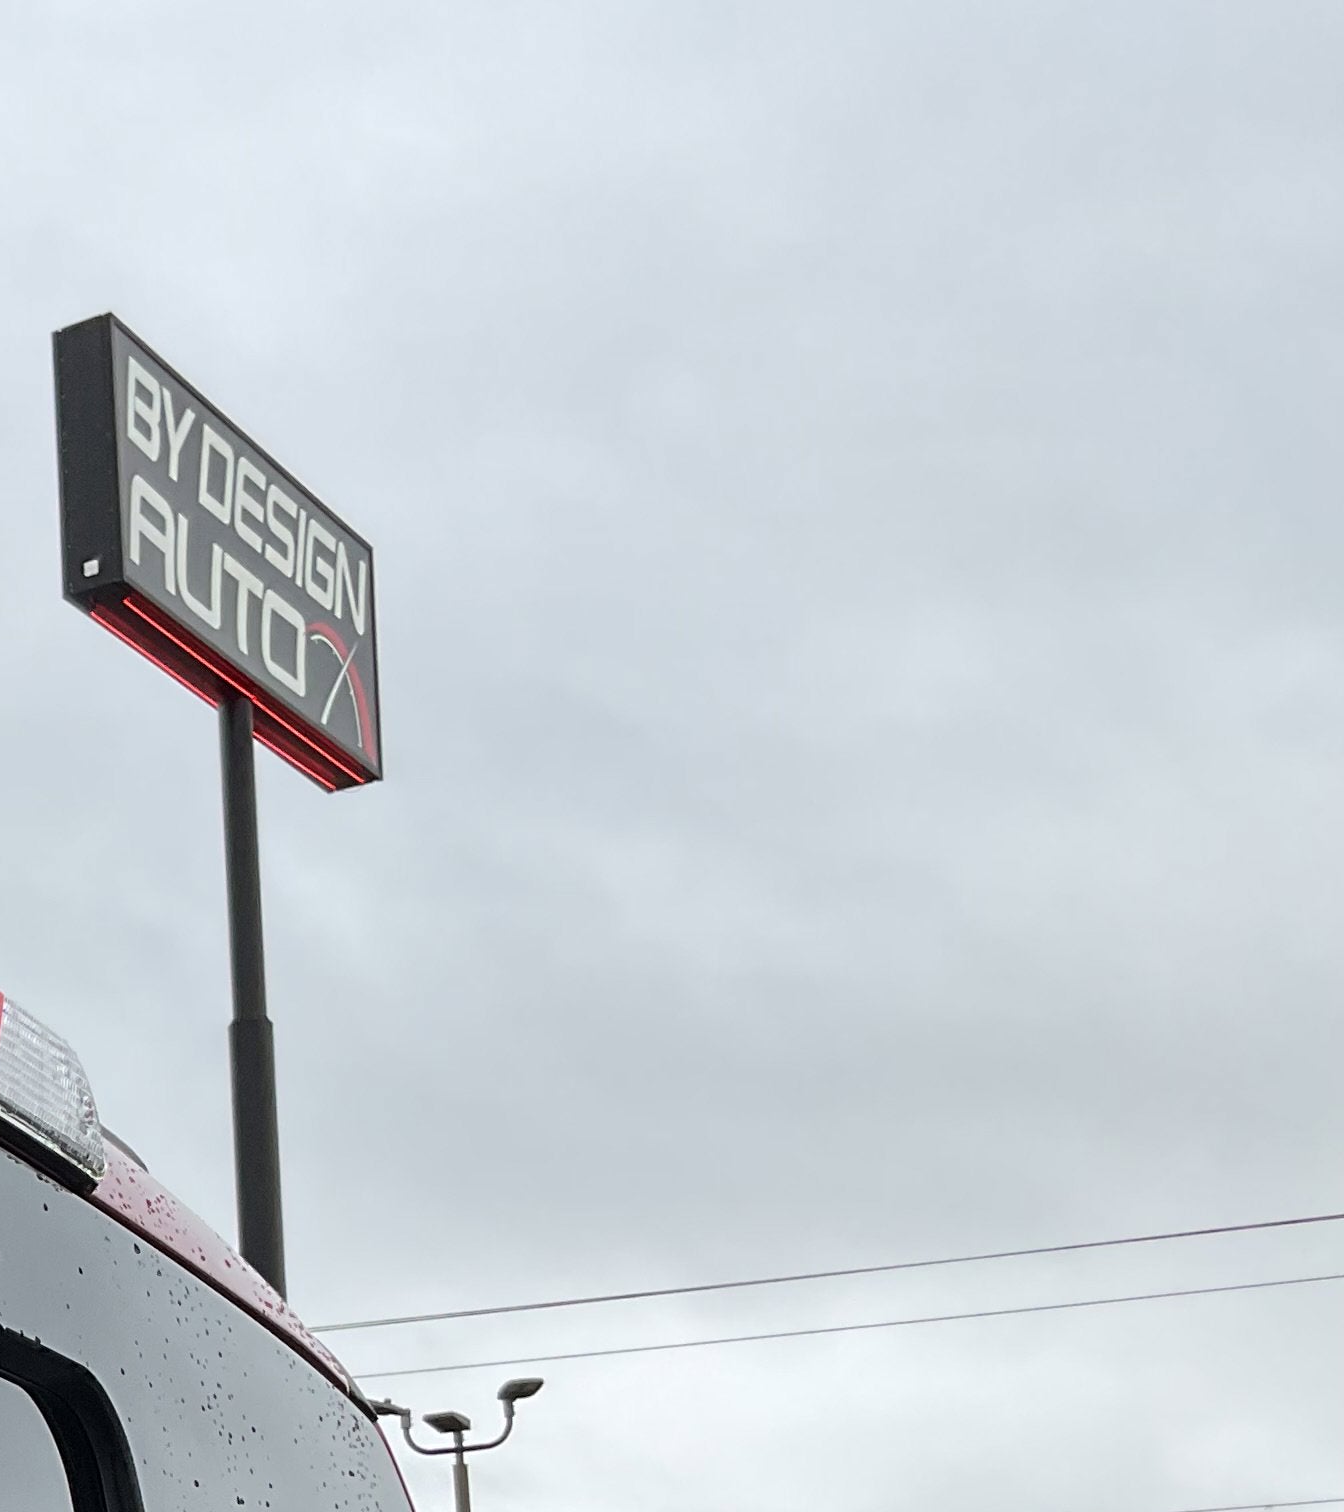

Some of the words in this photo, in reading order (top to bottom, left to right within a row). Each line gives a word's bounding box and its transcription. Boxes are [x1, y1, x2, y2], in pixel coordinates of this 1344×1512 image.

[127, 355, 196, 482] BY
[199, 423, 367, 636] DESIGN
[129, 474, 306, 698] AUTO
